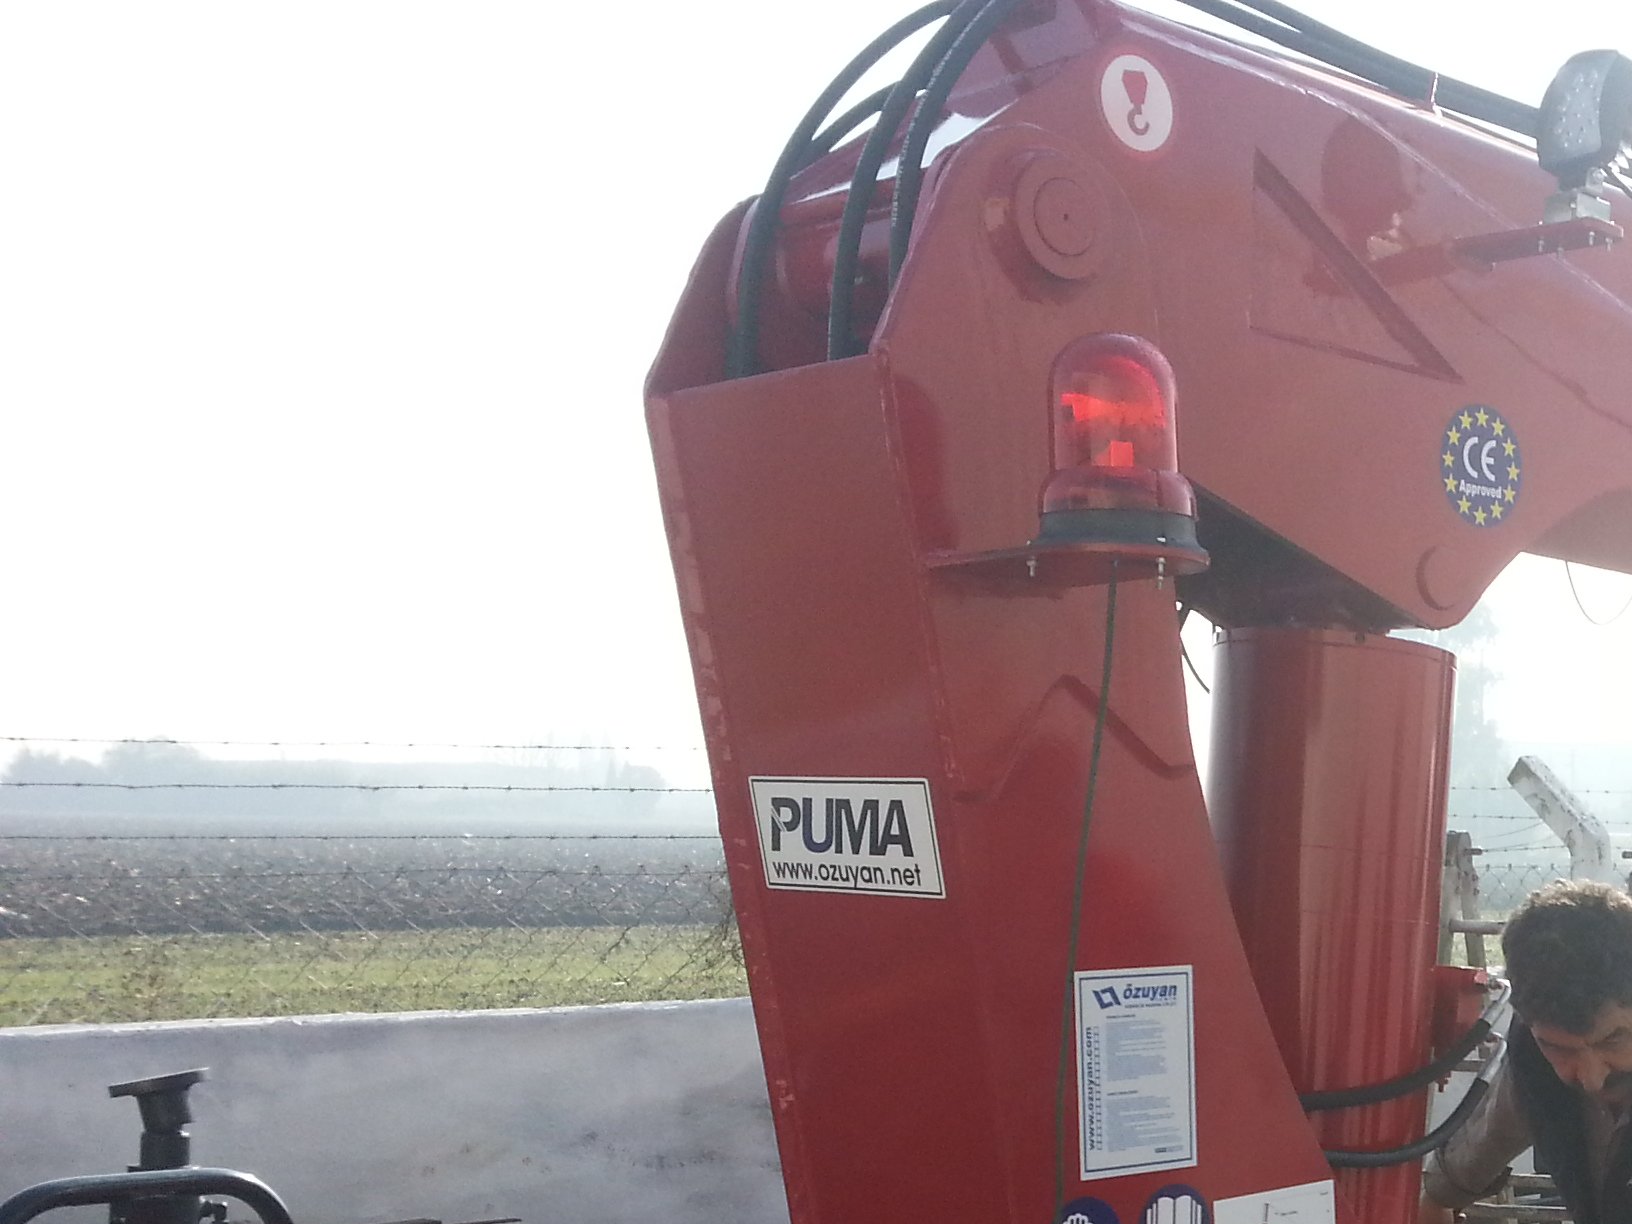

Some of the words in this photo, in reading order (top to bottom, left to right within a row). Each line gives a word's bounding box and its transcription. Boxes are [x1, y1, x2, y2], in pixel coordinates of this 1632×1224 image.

[1463, 436, 1497, 482] CE
[1459, 479, 1502, 499] Approved
[770, 797, 914, 857] PUMA
[773, 862, 922, 888] www.ozuyan.net
